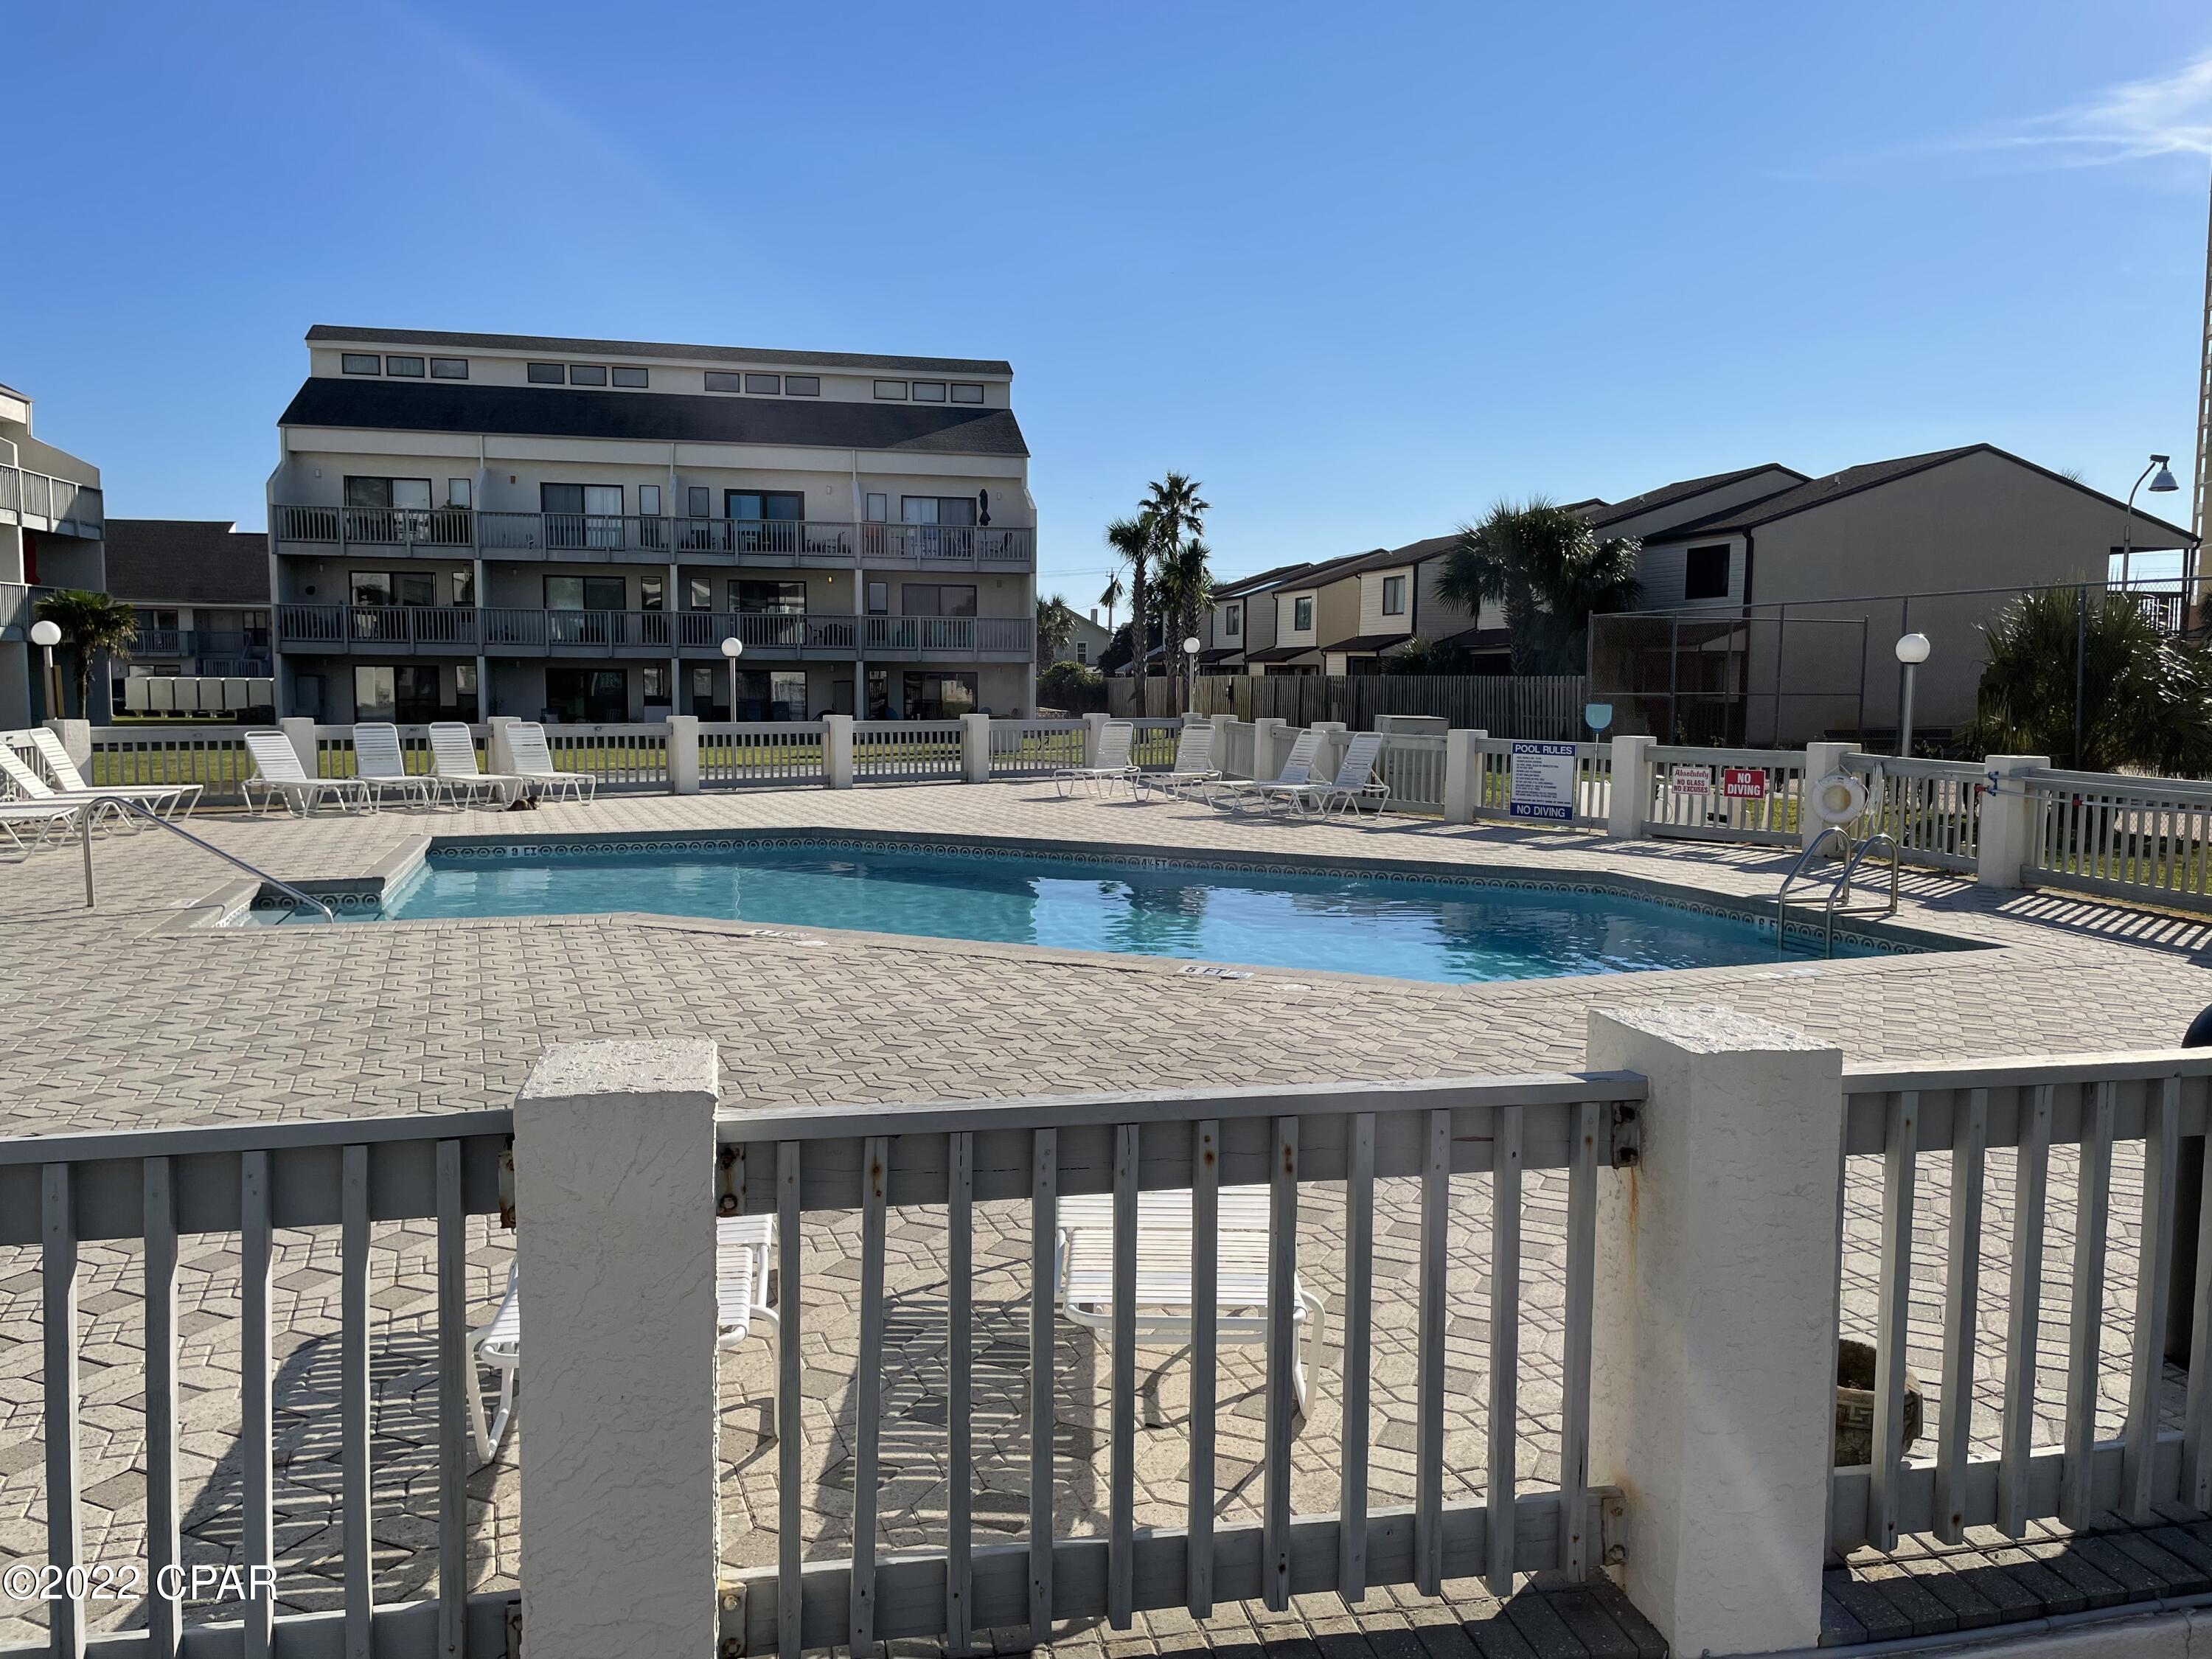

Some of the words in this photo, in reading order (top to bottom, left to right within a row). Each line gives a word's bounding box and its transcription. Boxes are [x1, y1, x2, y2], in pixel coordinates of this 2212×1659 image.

[1515, 745, 1540, 754] POOL
[1543, 745, 1572, 754] RULES
[1674, 769, 1709, 779] Absolutely
[1737, 773, 1750, 784] NO
[1683, 785, 1708, 793] EXCUSES
[1728, 784, 1761, 796] DIVING
[1517, 804, 1531, 814] NO
[1534, 806, 1565, 818] DIVING
